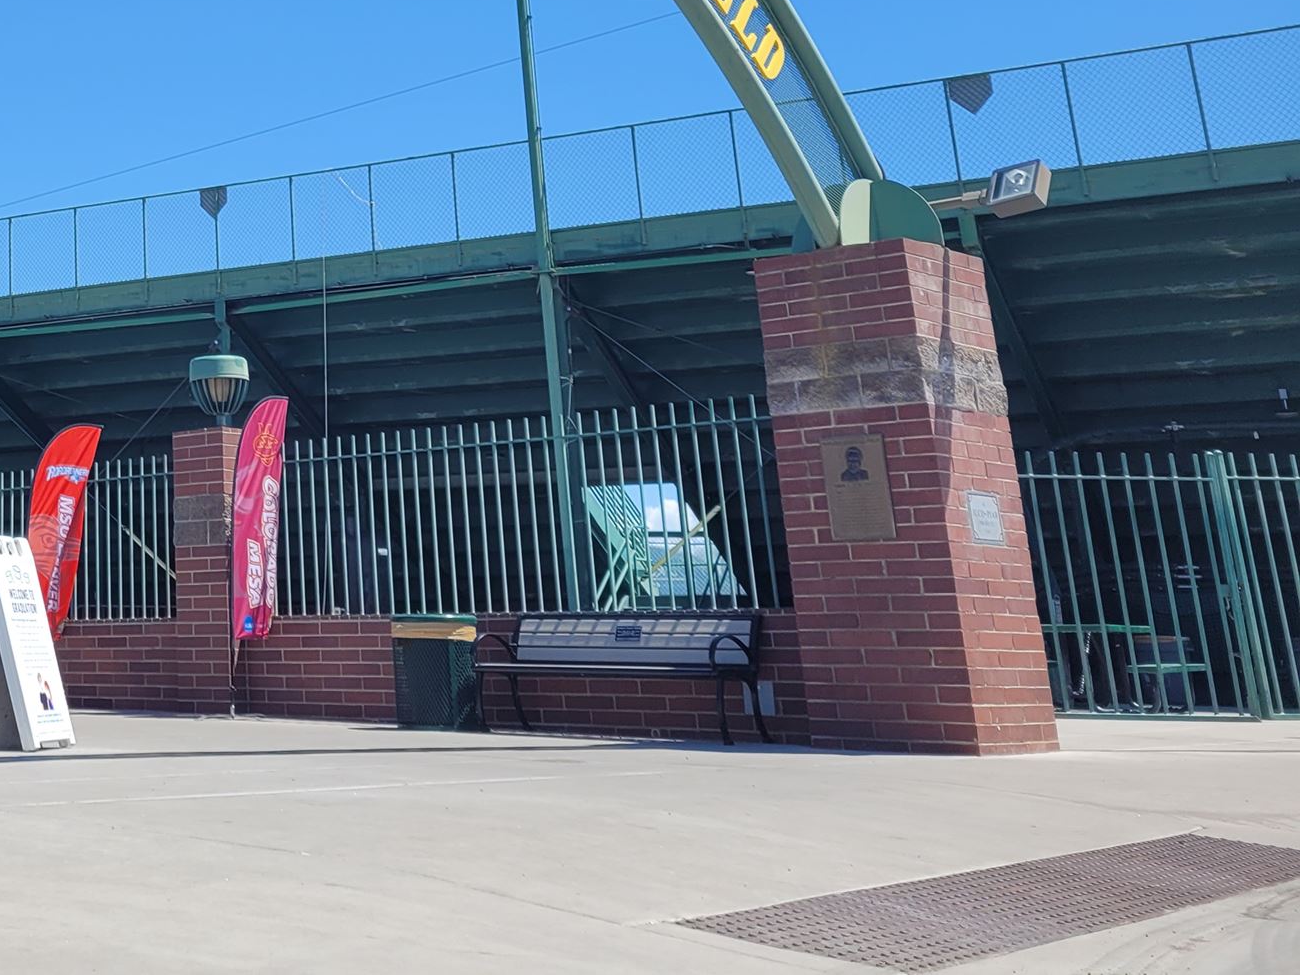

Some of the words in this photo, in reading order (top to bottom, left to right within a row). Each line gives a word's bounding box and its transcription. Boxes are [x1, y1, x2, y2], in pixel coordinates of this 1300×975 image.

[57, 494, 76, 539] MSU
[261, 475, 280, 609] COLORADO
[246, 538, 264, 609] MESA
